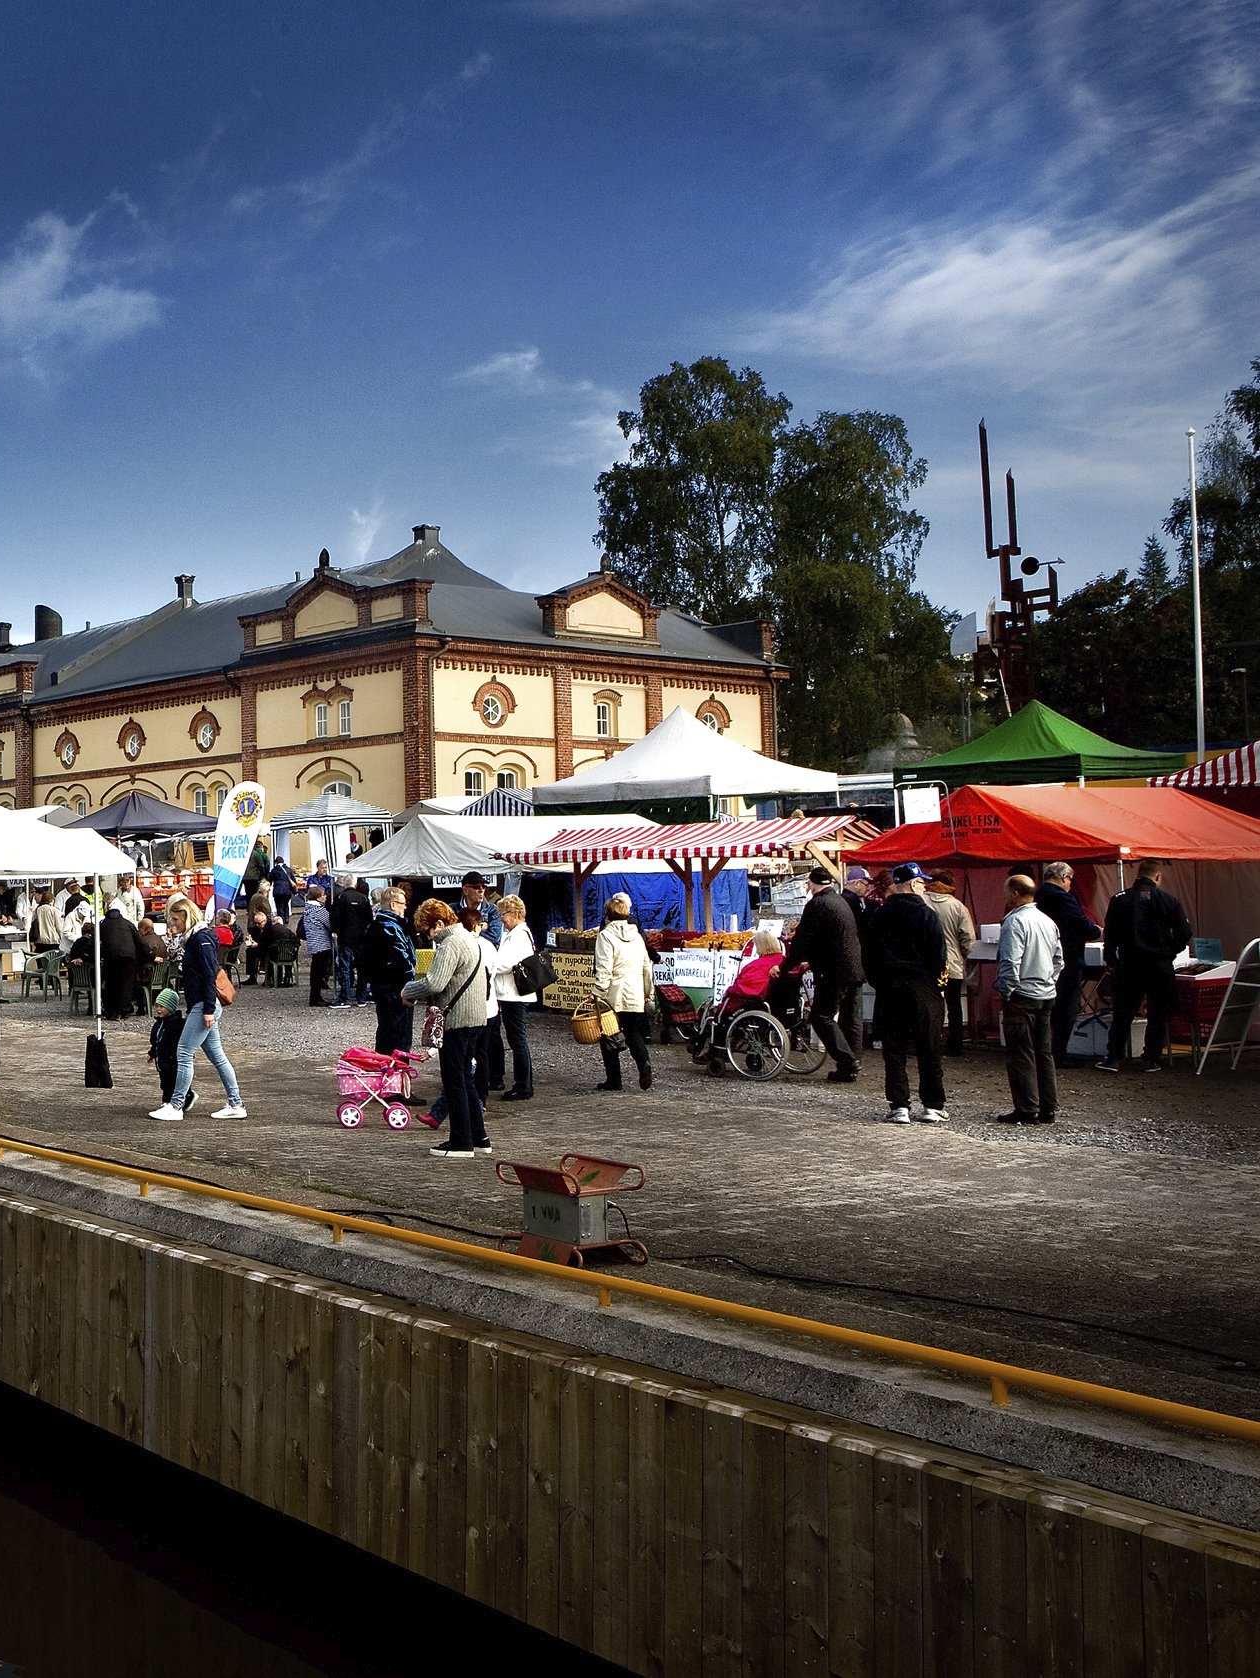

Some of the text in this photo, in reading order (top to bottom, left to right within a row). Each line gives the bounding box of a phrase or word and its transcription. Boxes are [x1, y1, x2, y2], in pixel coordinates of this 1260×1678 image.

[222, 834, 250, 846] VAASA
[436, 876, 446, 885] LC
[565, 957, 594, 966] nypotati
[562, 969, 578, 979] egen
[675, 968, 711, 978] KANTARELLI
